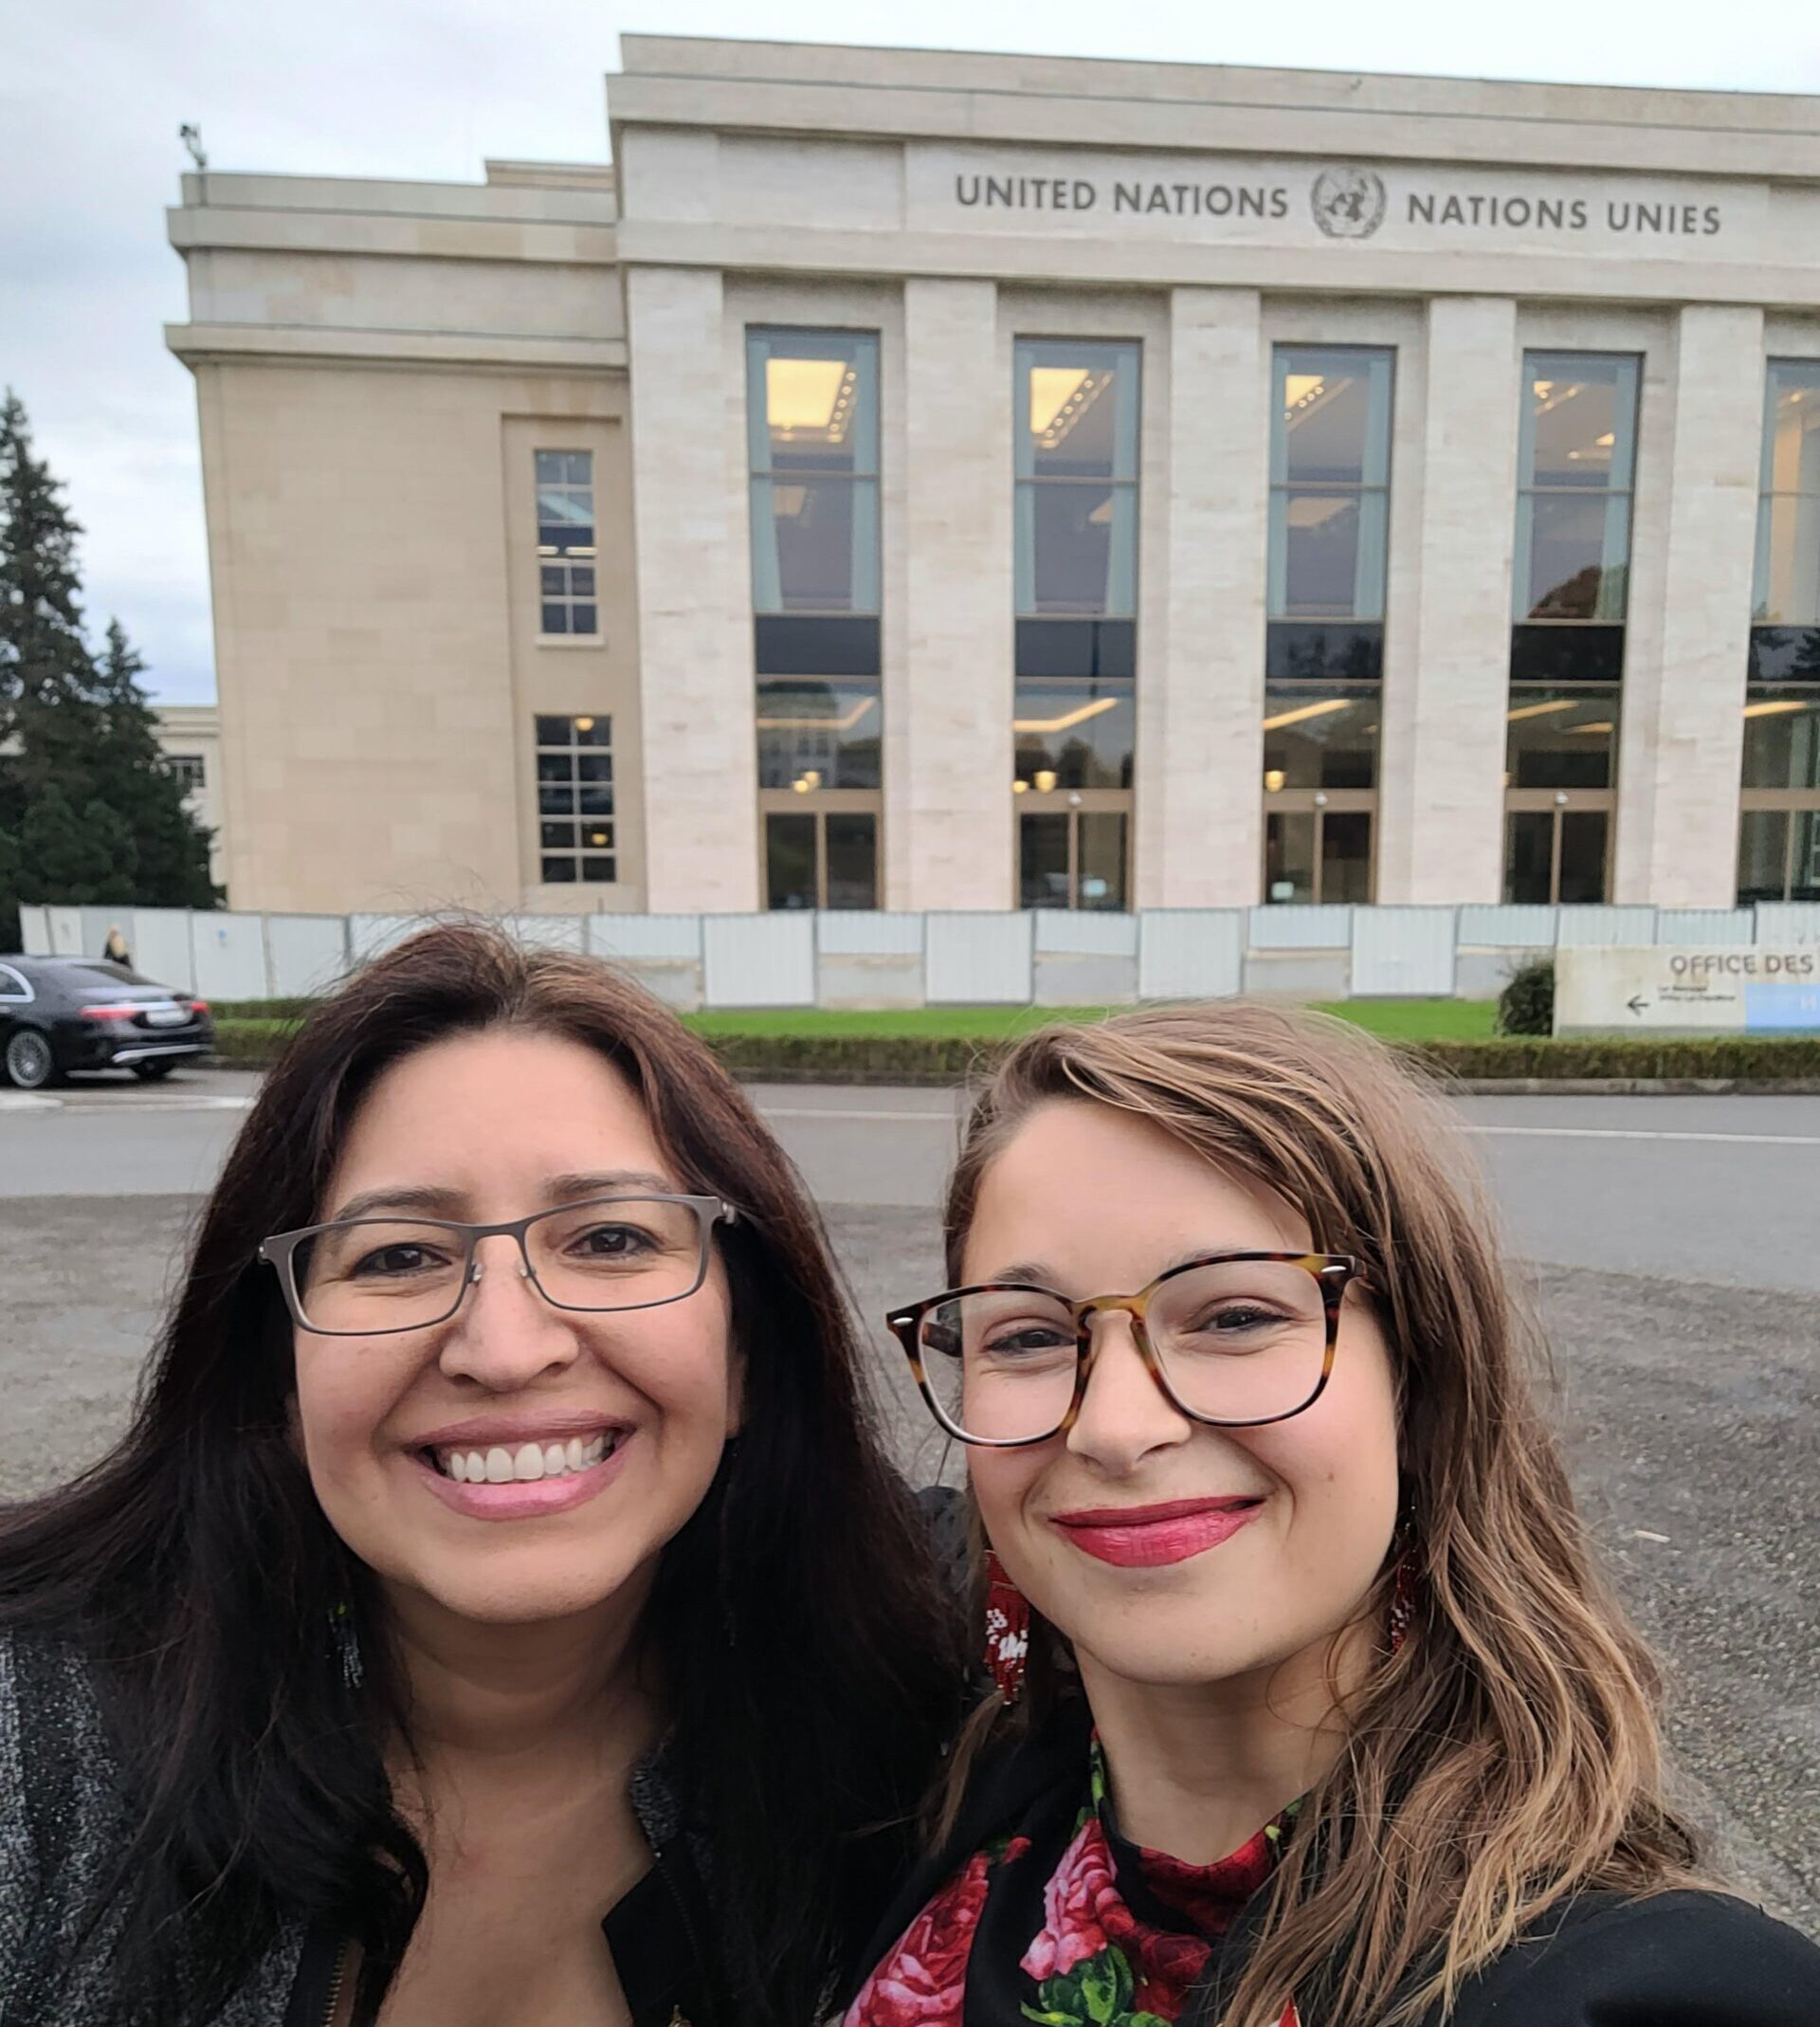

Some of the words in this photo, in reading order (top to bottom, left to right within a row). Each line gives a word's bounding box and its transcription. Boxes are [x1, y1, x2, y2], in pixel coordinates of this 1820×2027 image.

[956, 174, 1096, 210] UNITED
[1114, 182, 1288, 218] NATIONS
[1408, 193, 1588, 229] NATIONS
[1607, 201, 1720, 235] UNIES
[1670, 954, 1757, 975] OFFICE
[1765, 954, 1813, 975] DES
